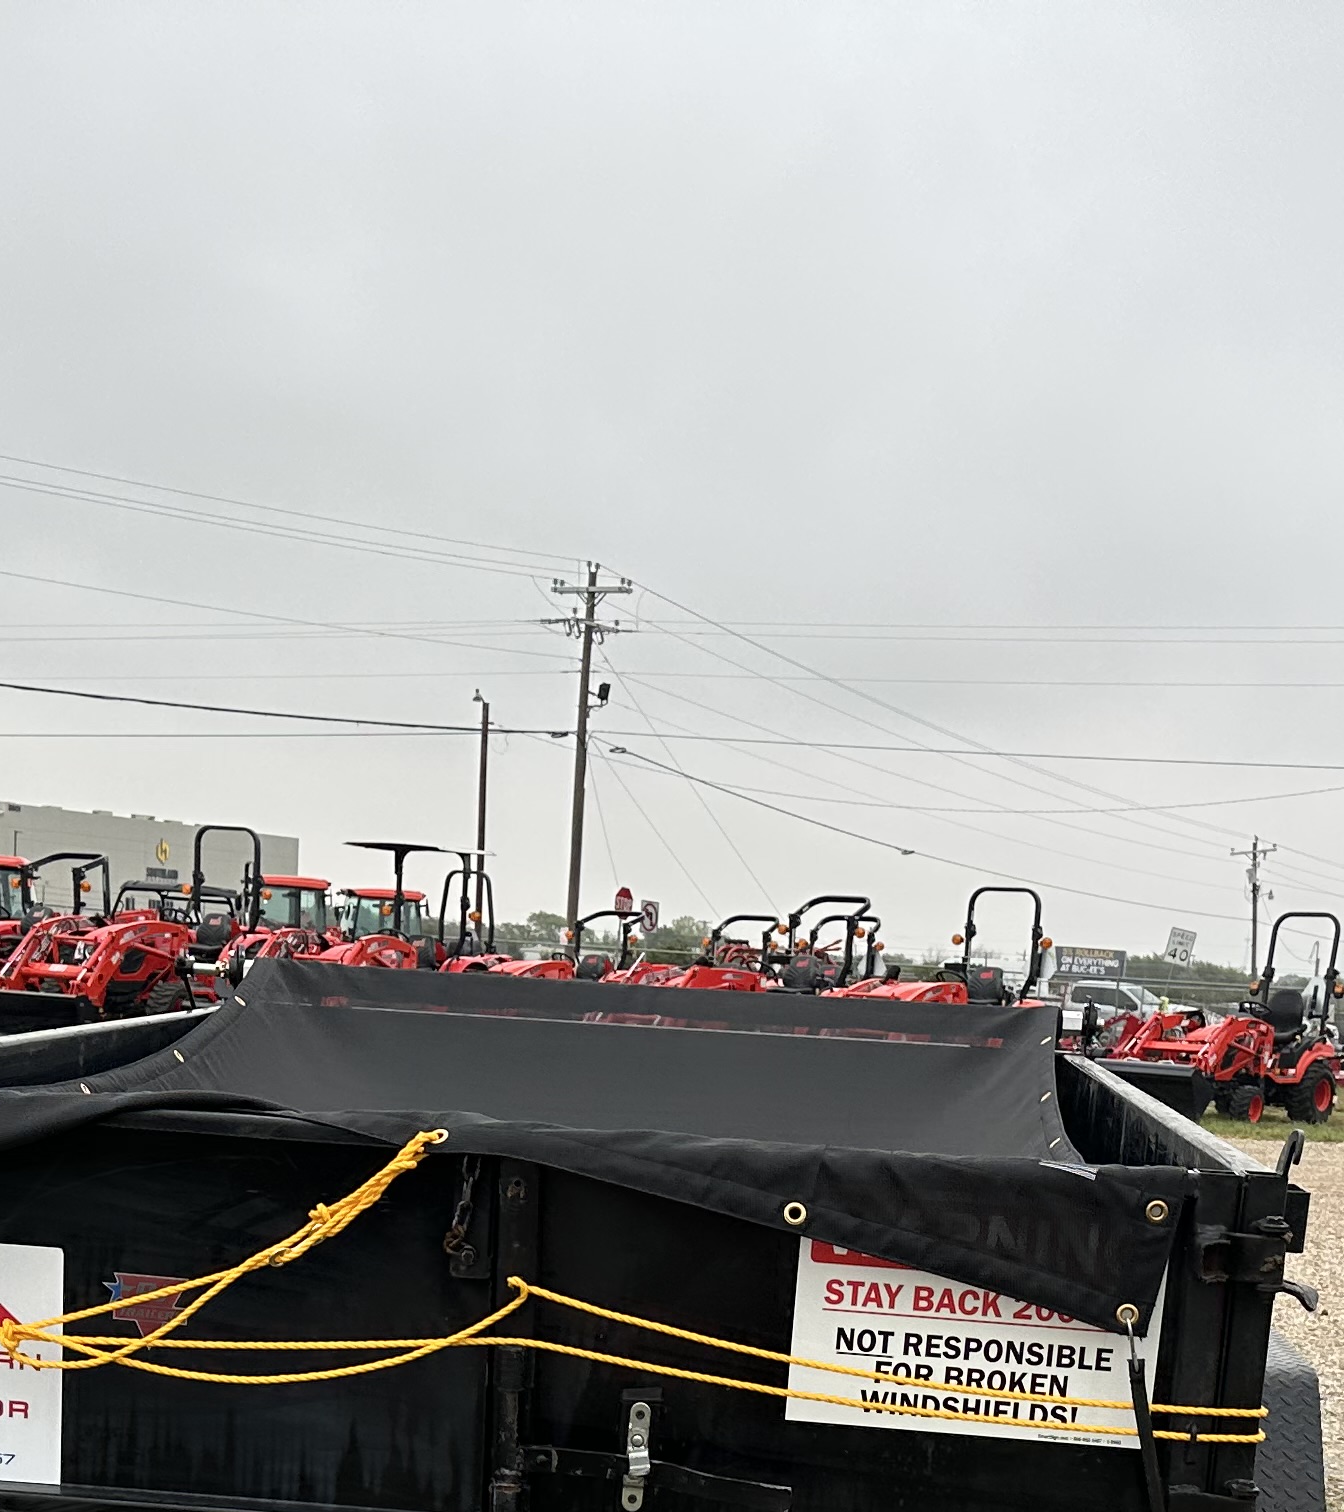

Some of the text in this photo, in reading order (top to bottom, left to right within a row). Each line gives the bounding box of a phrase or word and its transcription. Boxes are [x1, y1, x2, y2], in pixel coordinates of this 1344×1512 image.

[1168, 948, 1188, 962] 40
[823, 1278, 905, 1310] STAY
[912, 1285, 1003, 1318] BACK
[835, 1327, 1114, 1372] NOT RESPONSIBLE
[943, 1366, 1070, 1398] BROKEN
